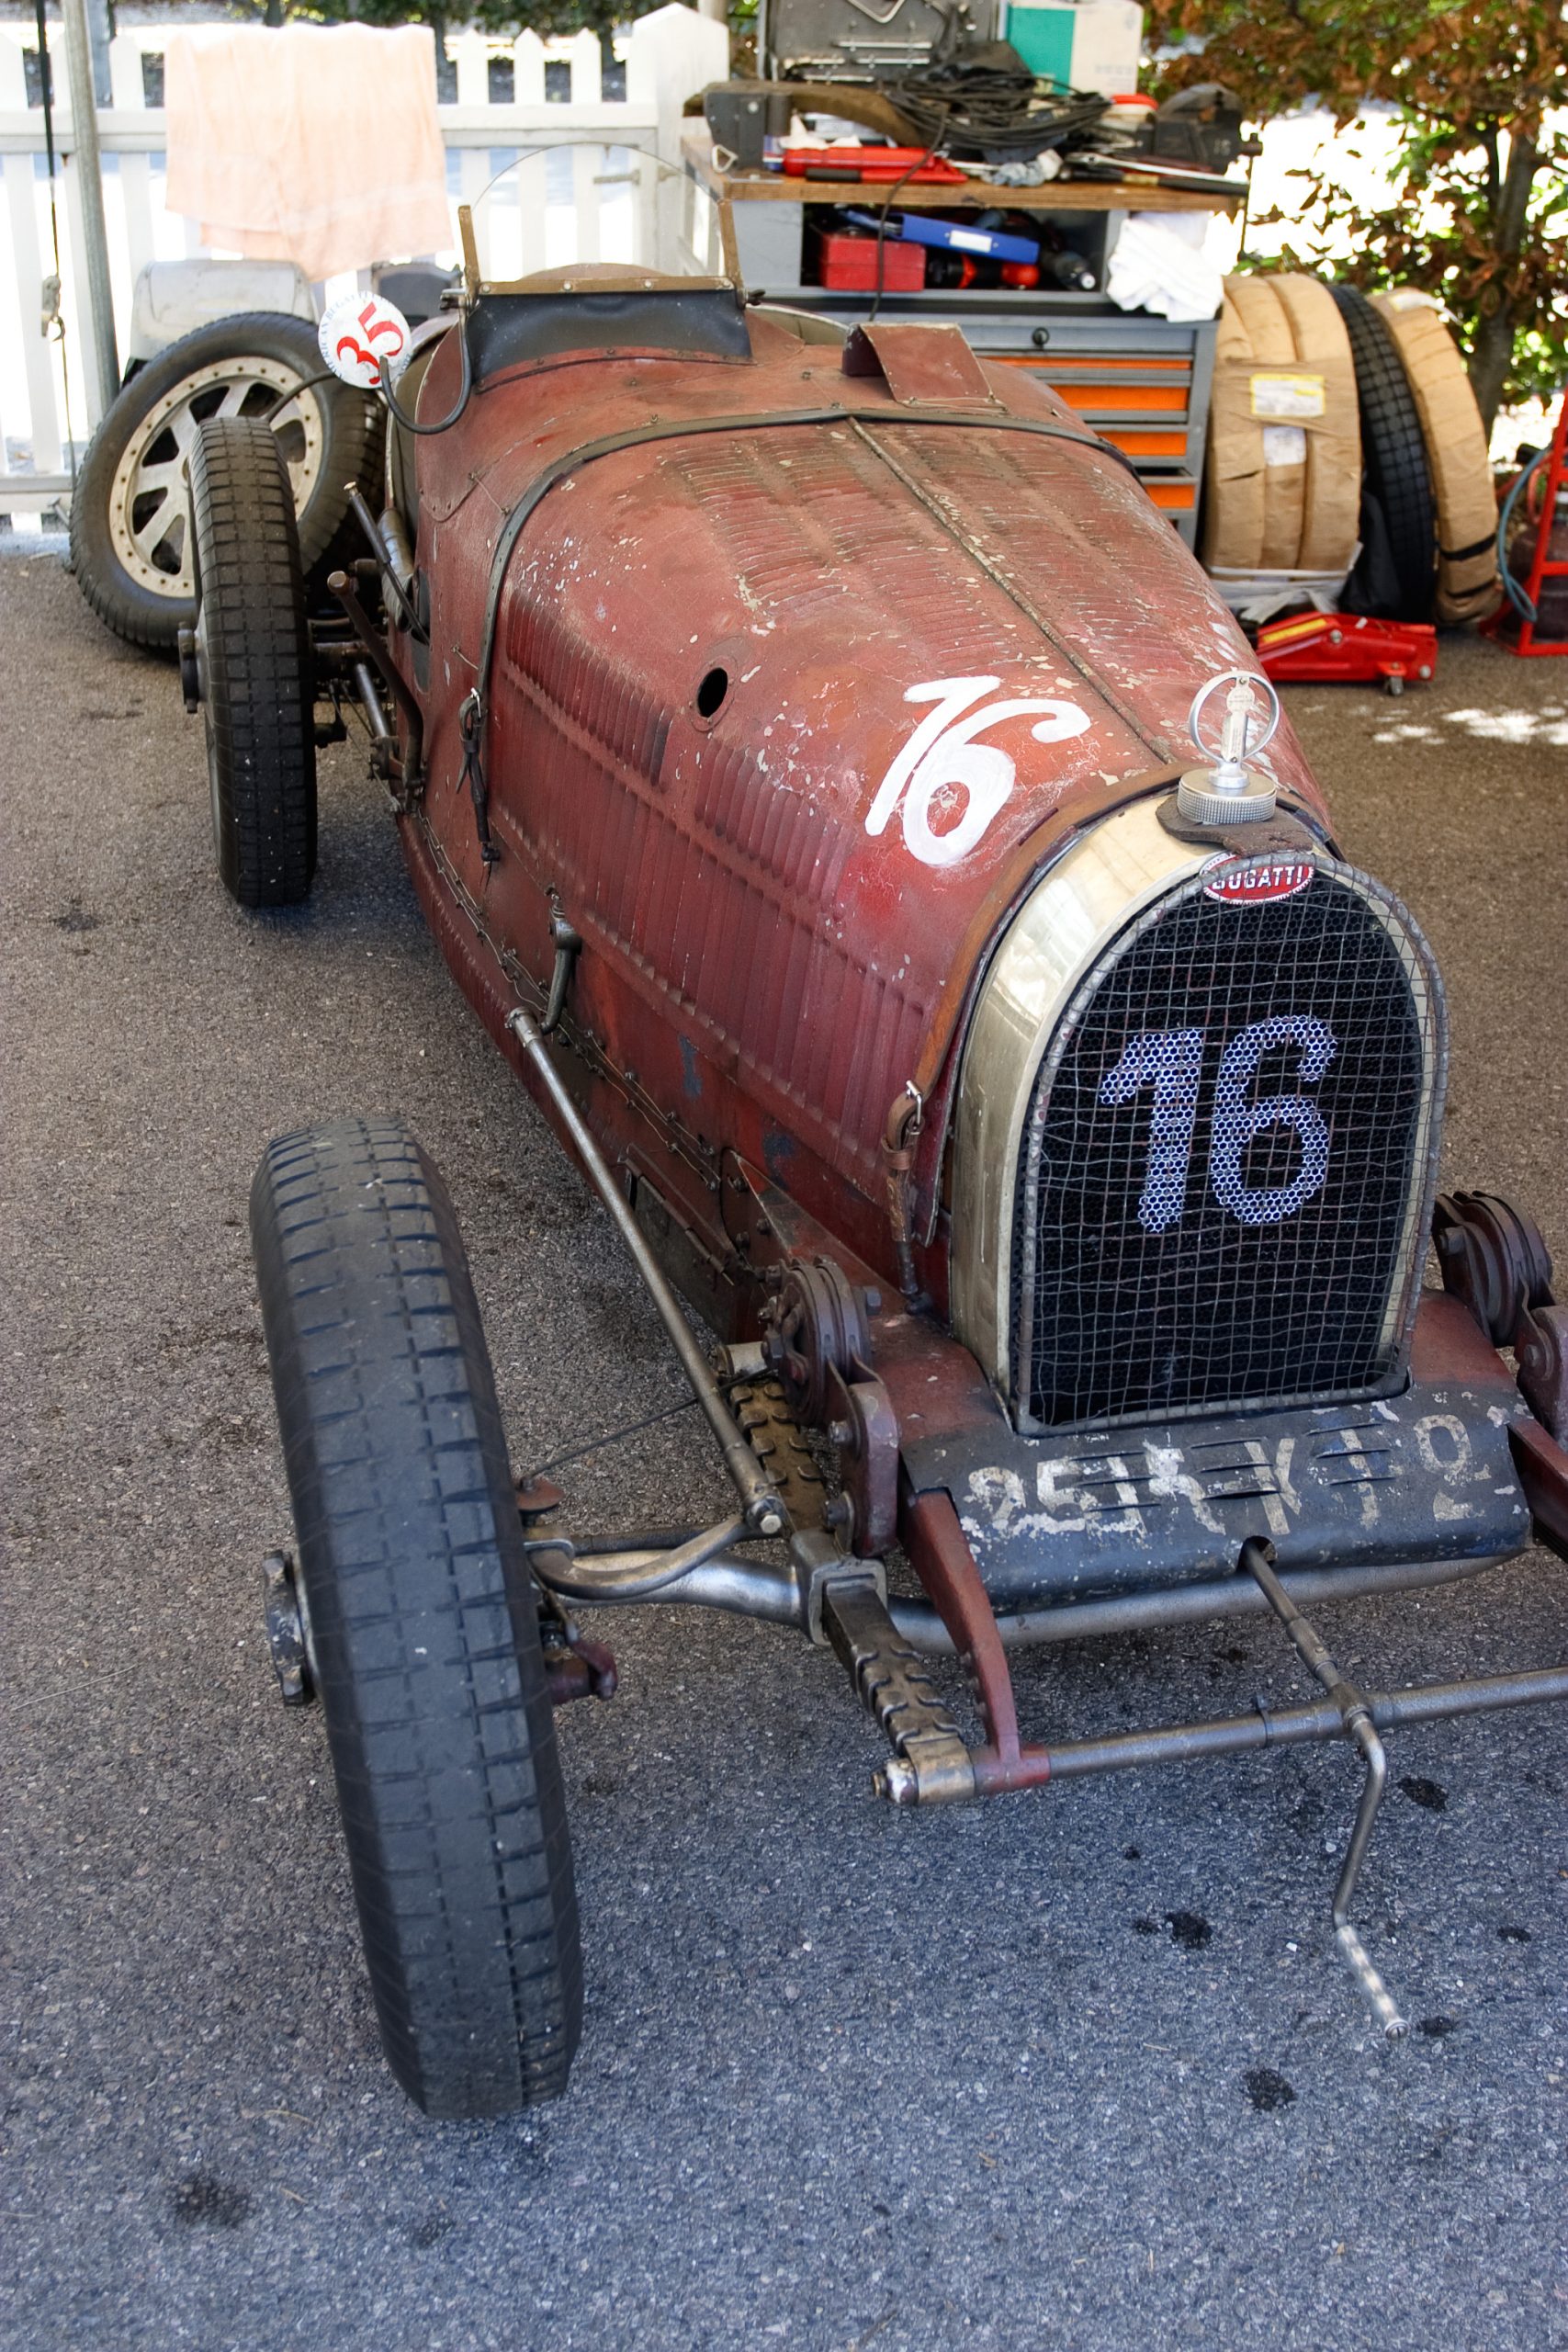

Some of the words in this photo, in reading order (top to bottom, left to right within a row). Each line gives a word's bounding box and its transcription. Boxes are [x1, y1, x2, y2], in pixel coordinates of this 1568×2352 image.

[336, 301, 404, 385] 35
[864, 675, 1091, 868] 16
[1212, 865, 1303, 890] BUGATTI
[1099, 1014, 1338, 1233] 16
